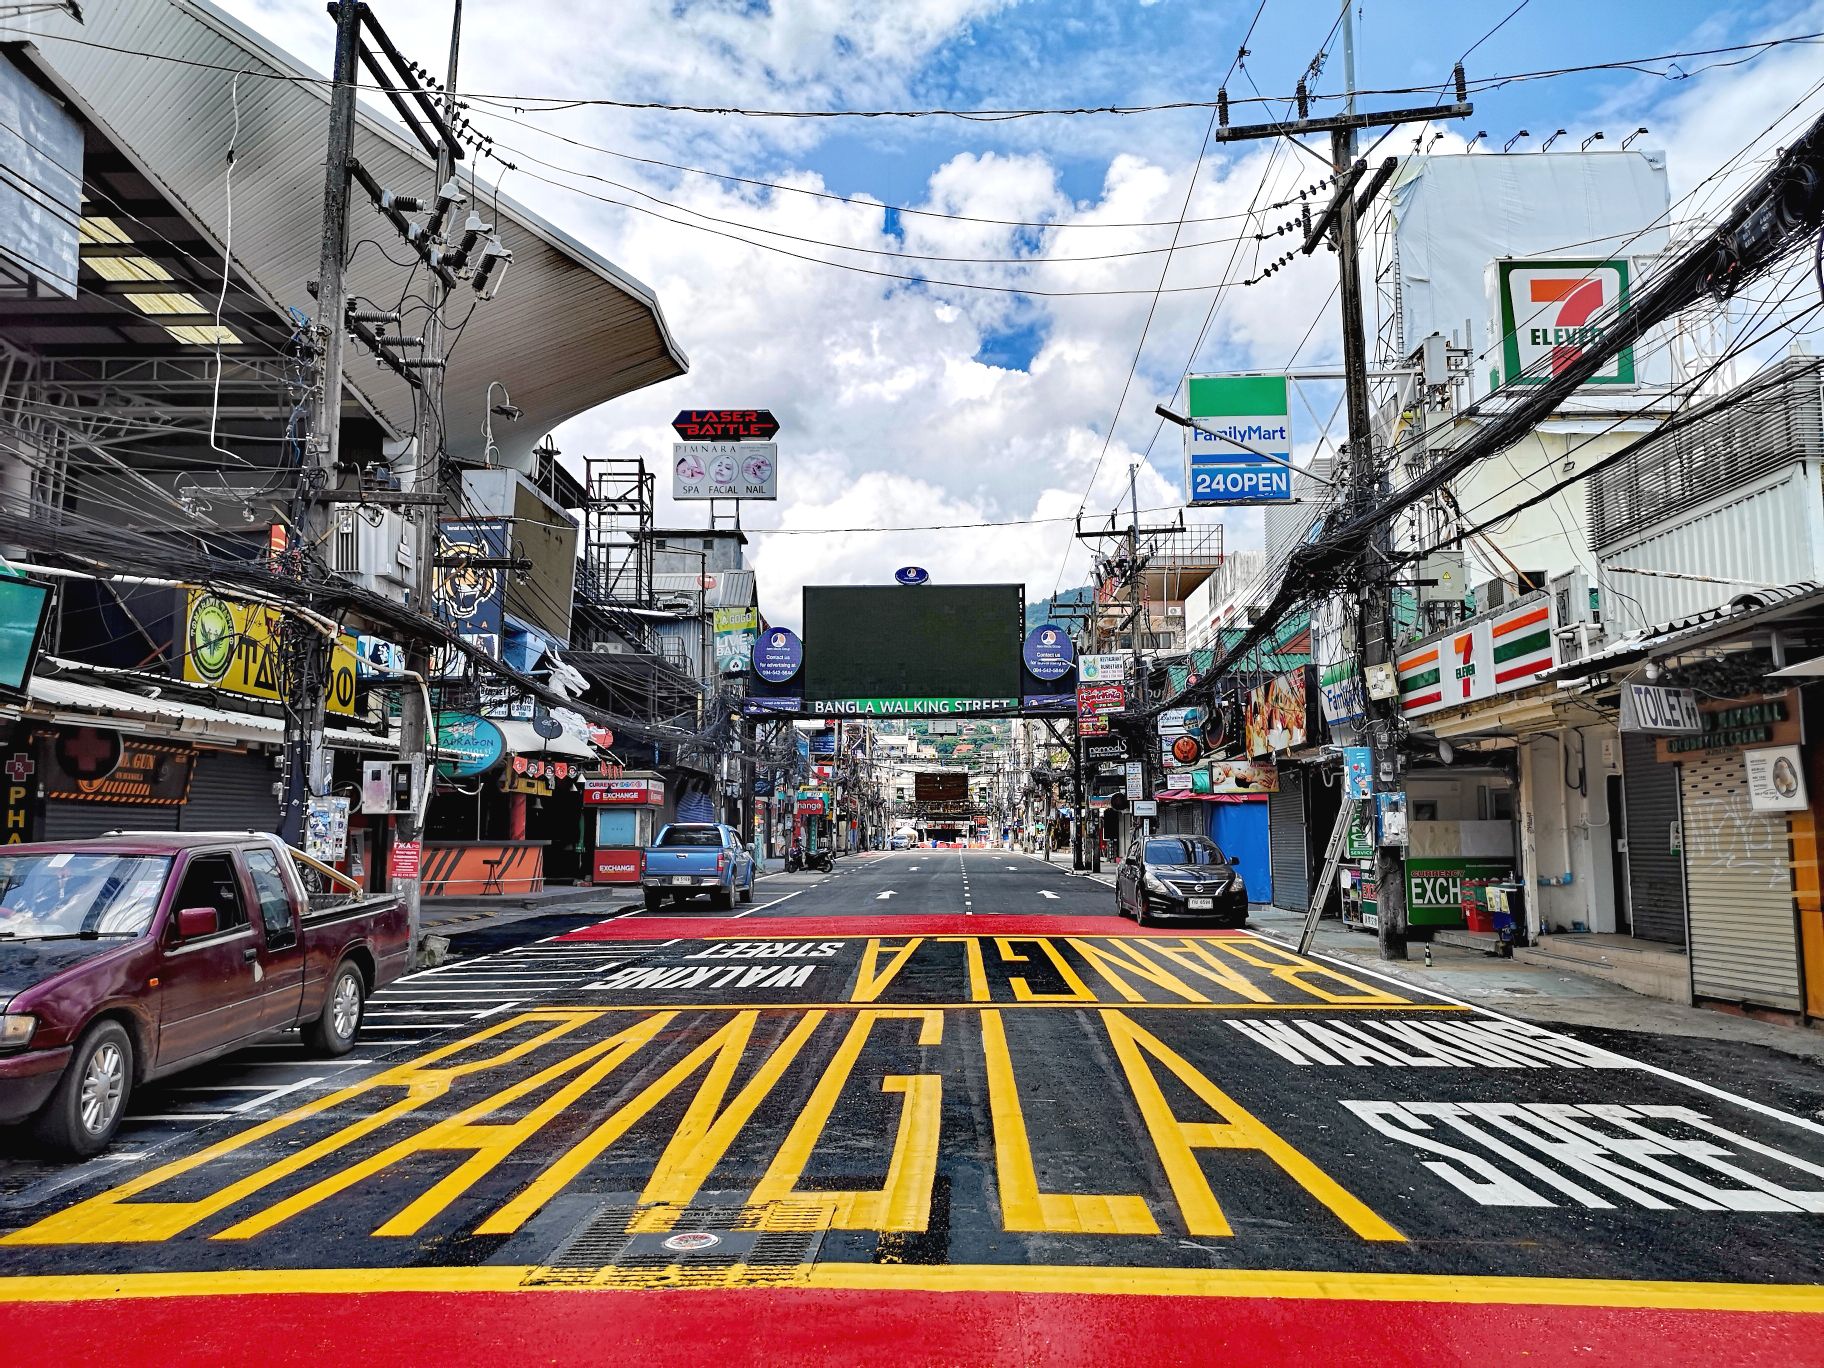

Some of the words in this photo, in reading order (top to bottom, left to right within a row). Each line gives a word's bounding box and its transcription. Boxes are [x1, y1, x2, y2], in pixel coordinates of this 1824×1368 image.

[691, 411, 757, 422] LASER
[675, 424, 774, 435] BATTLE
[682, 486, 700, 494] SPA
[708, 486, 738, 494] FACIAL
[745, 486, 766, 494] NAIL
[815, 700, 876, 713] BANGLA
[879, 700, 950, 713] WALKING
[954, 700, 1010, 713] STREET
[1633, 686, 1688, 728] TOILET
[1410, 870, 1466, 878] CURRENCY
[683, 942, 846, 959] STREET
[579, 965, 808, 990] WALKING
[850, 936, 1414, 1003] BANGLA
[1222, 1019, 1645, 1069] WALKING
[0, 1008, 1411, 1244] BANGLA
